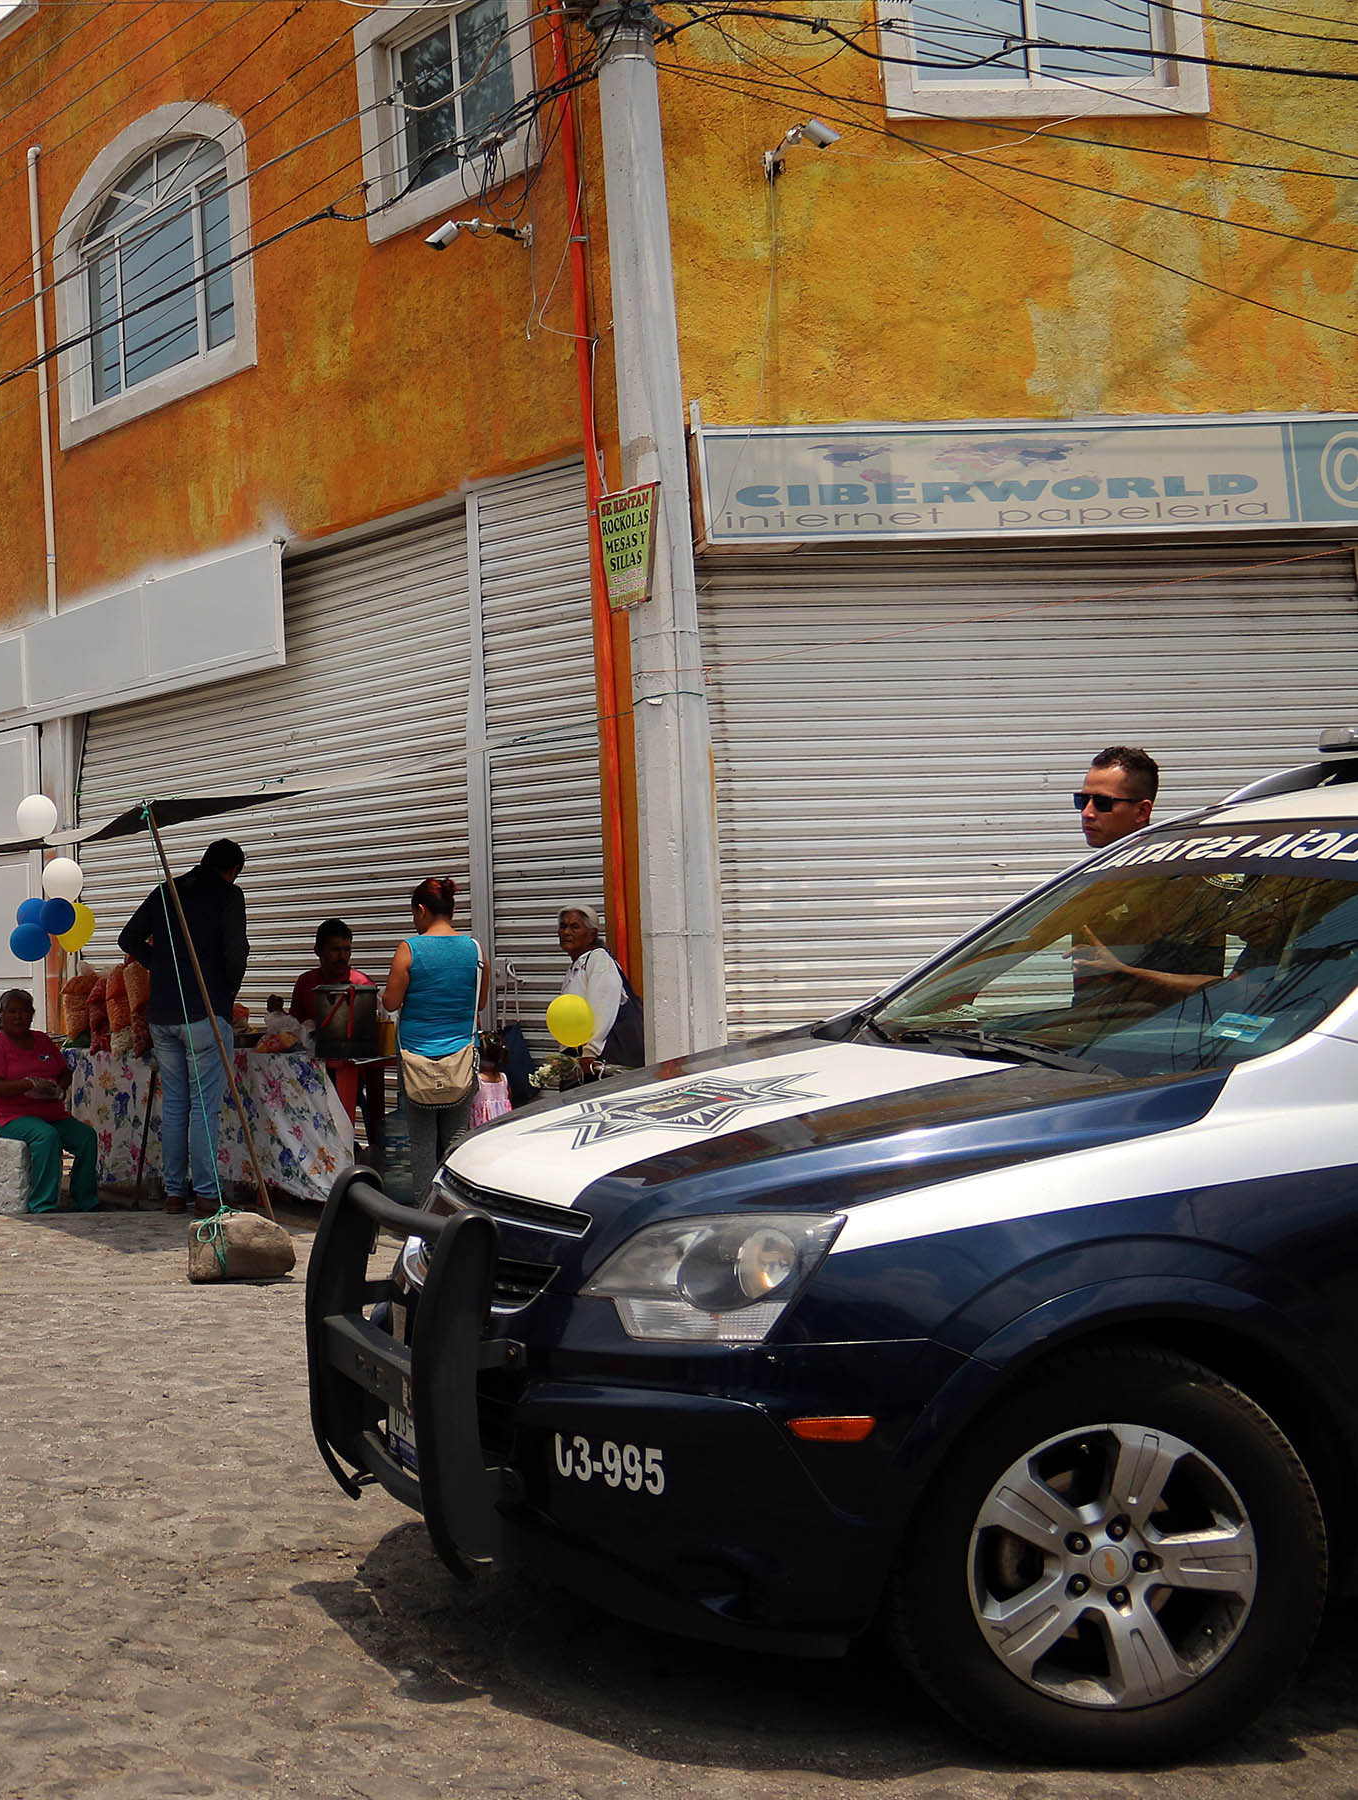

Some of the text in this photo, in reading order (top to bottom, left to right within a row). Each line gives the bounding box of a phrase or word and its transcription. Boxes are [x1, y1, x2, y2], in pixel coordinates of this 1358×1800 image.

[735, 473, 1259, 507] CIBERWORLD
[601, 508, 650, 537] ROCKOLAS
[725, 499, 1269, 529] internet papeleria
[605, 530, 648, 555] MESAS Y
[609, 550, 643, 572] SILLAS
